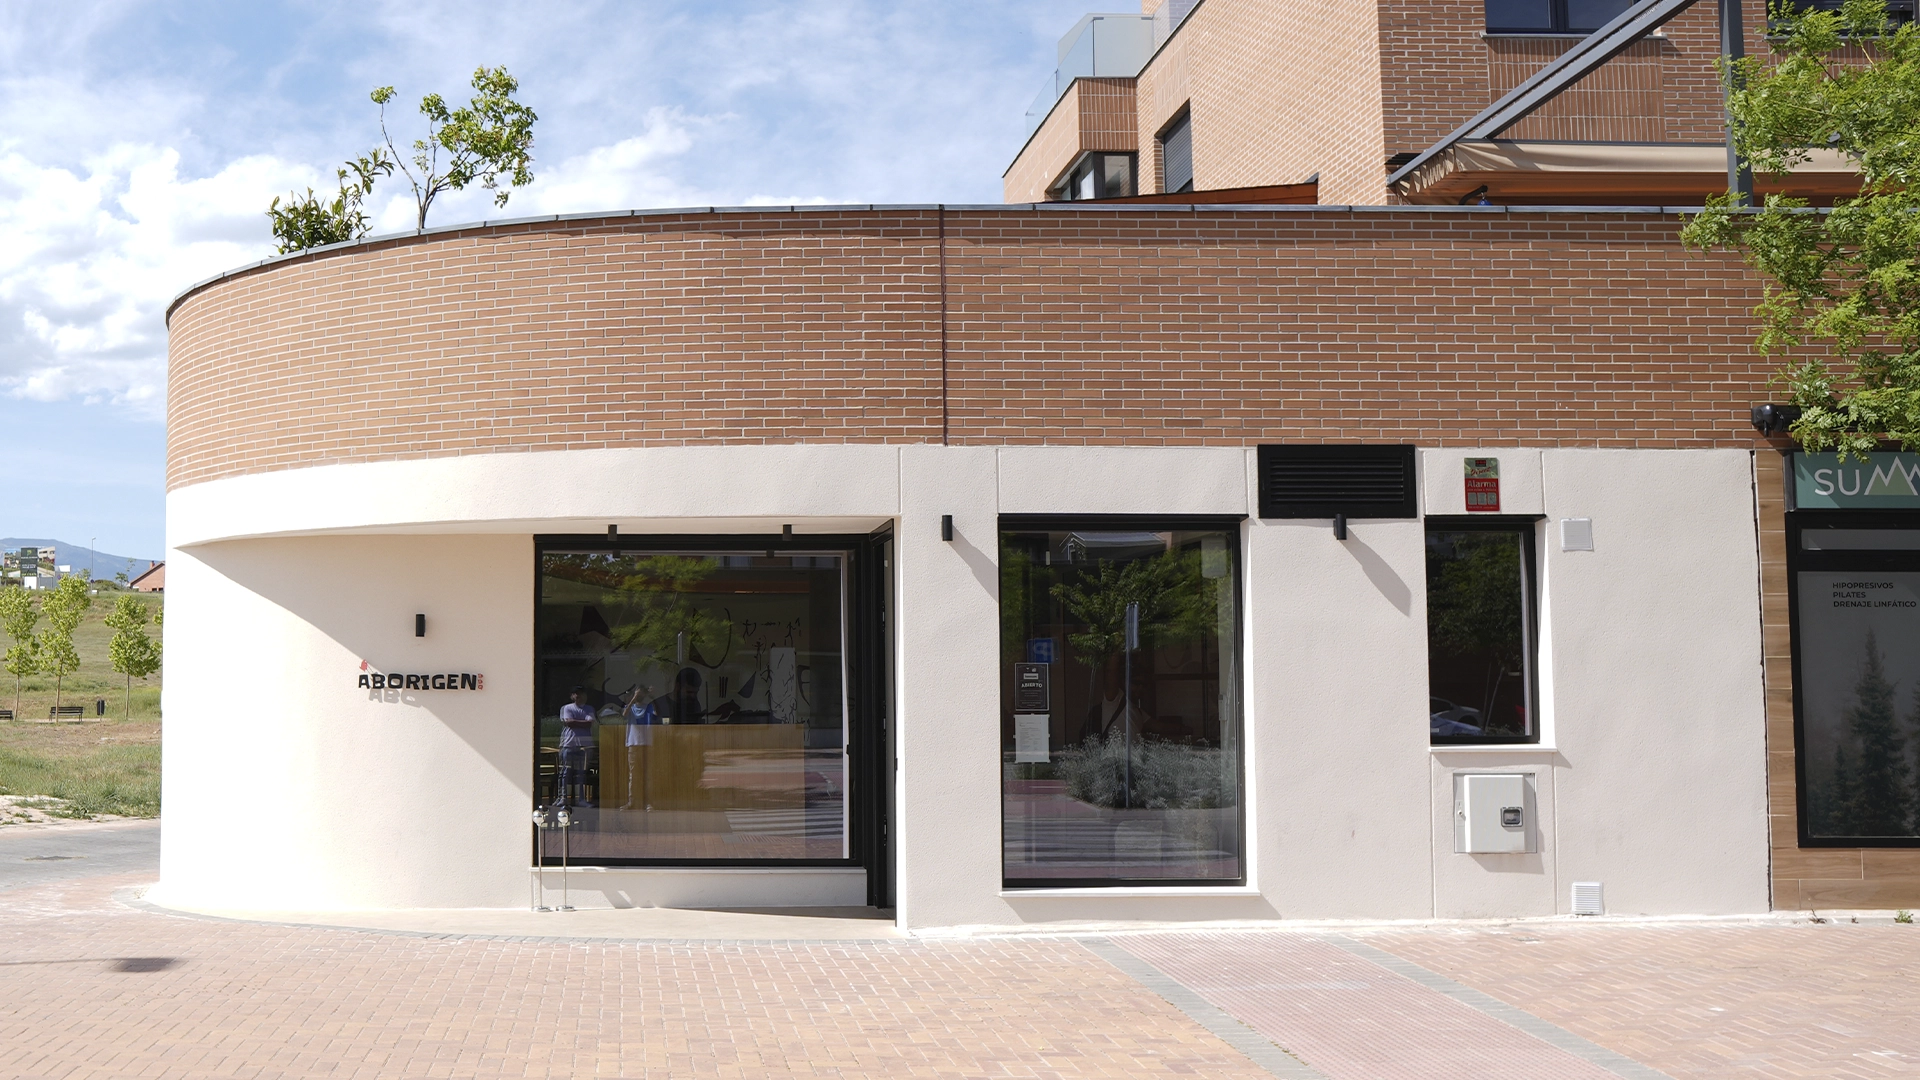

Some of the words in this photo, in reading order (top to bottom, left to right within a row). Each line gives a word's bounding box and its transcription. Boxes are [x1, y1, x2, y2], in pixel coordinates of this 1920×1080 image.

[1467, 480, 1496, 488] Alarma
[1874, 599, 1917, 608] LINFÁTICO
[358, 673, 477, 690] ABORIGEN
